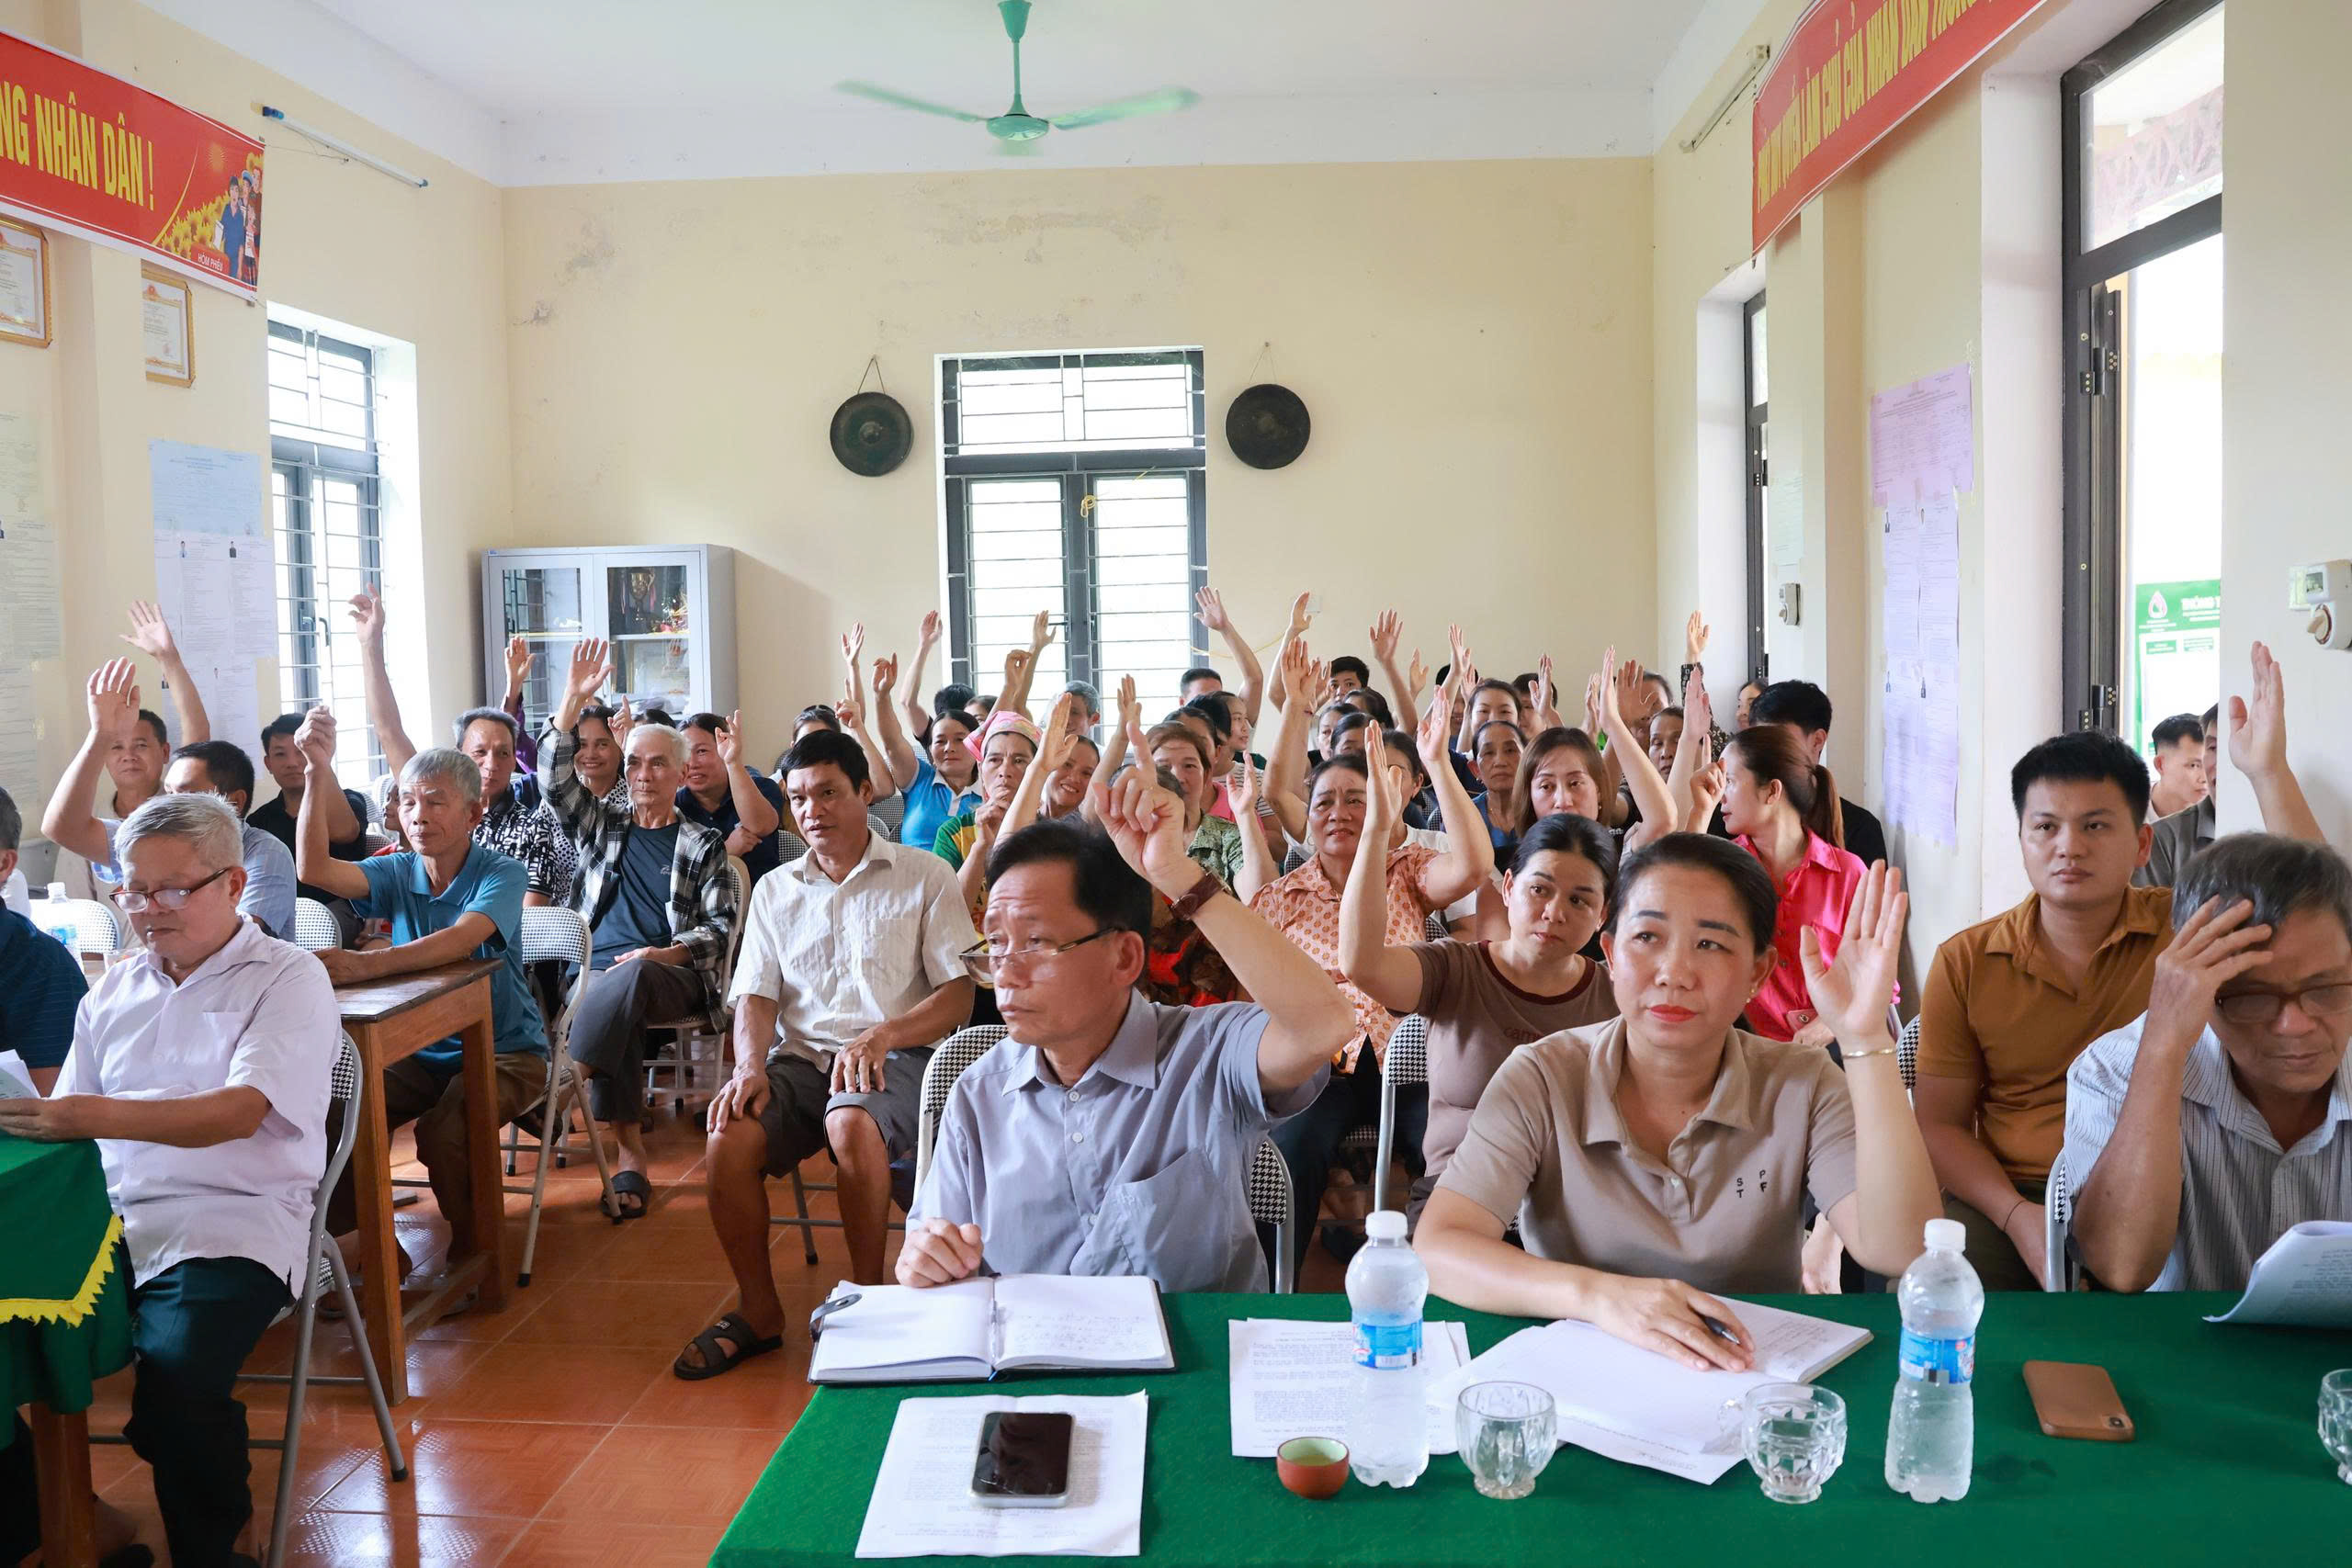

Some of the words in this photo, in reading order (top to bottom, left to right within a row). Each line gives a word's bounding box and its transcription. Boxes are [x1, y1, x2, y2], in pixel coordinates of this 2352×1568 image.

[35, 91, 97, 190] NHÂN
[102, 111, 143, 207] DÂN
[1801, 67, 1821, 160] LÀM
[1822, 18, 1841, 140] CHỦ
[1843, 1, 1865, 120] CỦA
